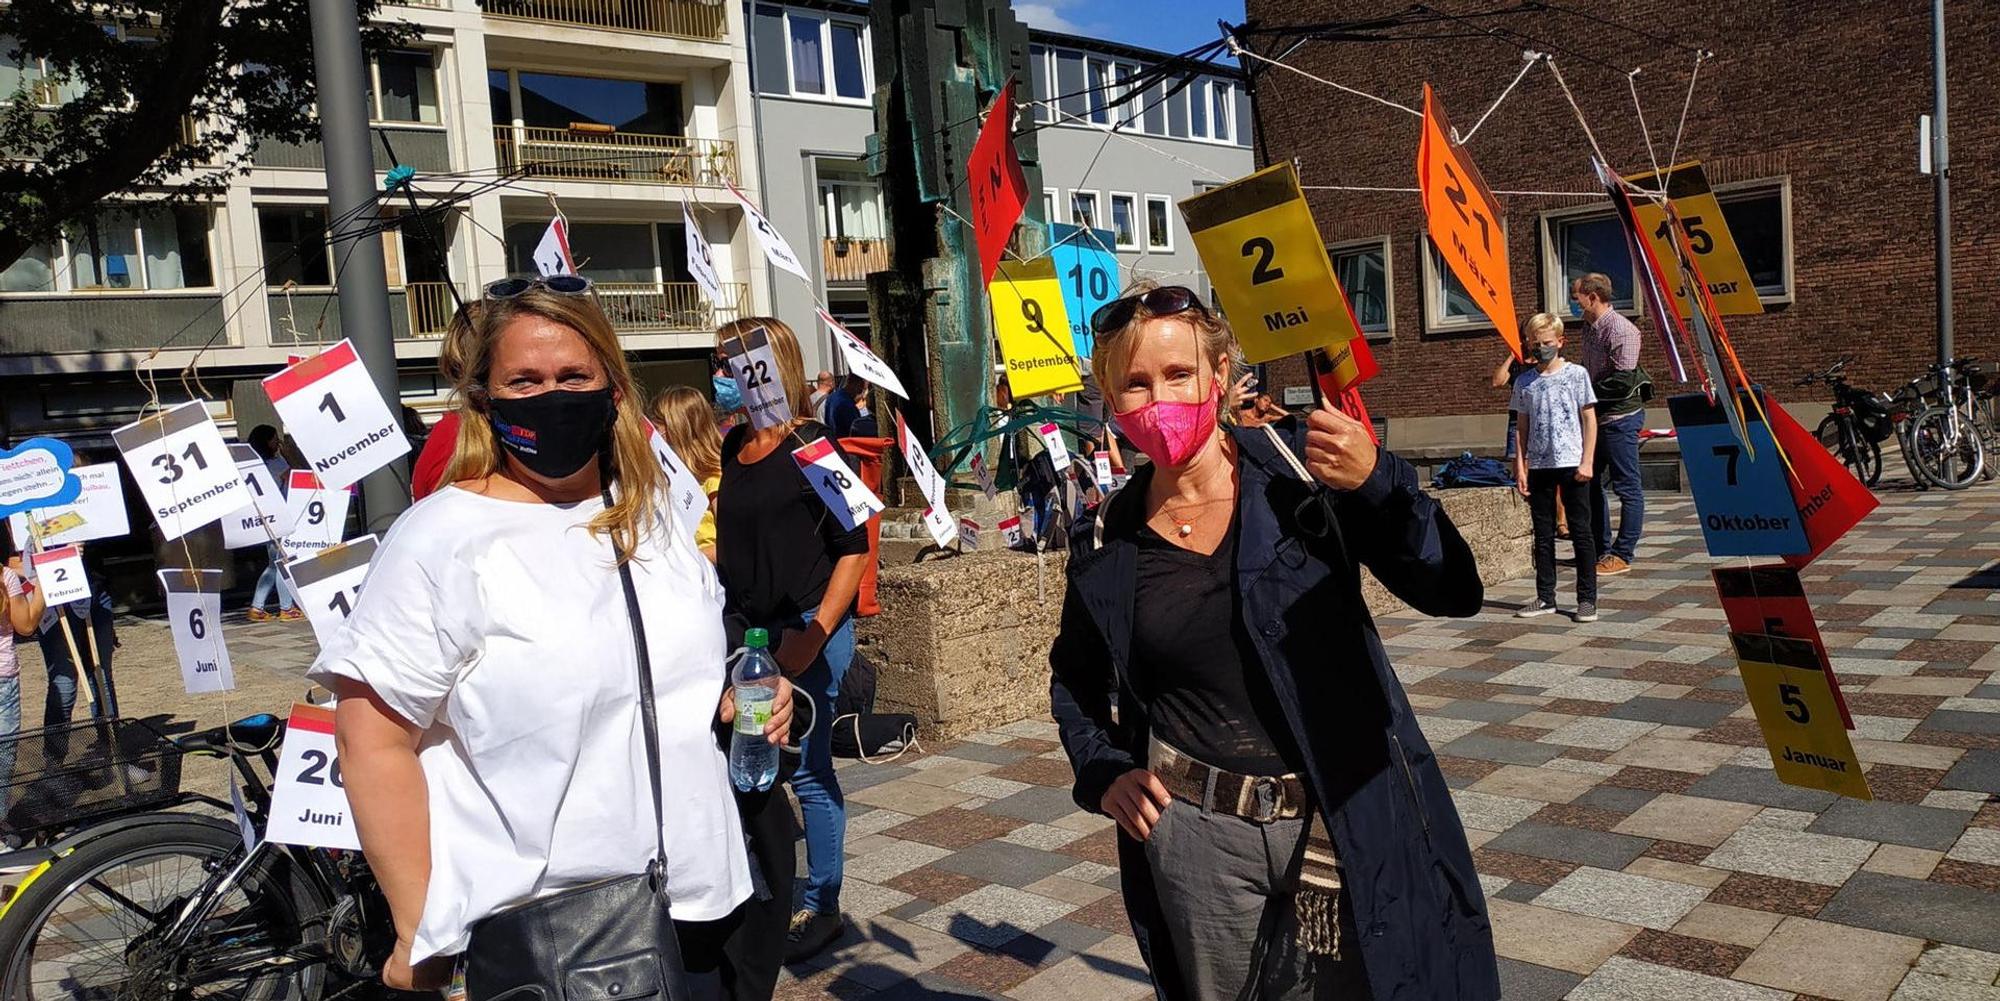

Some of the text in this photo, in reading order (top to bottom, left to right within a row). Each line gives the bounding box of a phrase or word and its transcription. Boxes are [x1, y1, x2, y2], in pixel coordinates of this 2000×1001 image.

[1444, 162, 1491, 258] 21
[1655, 216, 1714, 255] 15
[1242, 236, 1284, 286] 2
[1452, 229, 1498, 304] März
[1068, 263, 1109, 301] 10
[1676, 280, 1739, 298] Juar
[1021, 298, 1044, 333] 9
[1263, 306, 1309, 332] Mai
[742, 359, 772, 390] 22
[1009, 353, 1074, 372] September
[318, 391, 346, 423] 1
[315, 423, 395, 472] November
[151, 441, 208, 484] 31
[1712, 445, 1739, 486] 7
[0, 483, 22, 498] egen
[244, 472, 264, 496] 1
[822, 470, 852, 496] 18
[158, 478, 239, 519] September
[308, 501, 325, 525] 9
[847, 500, 870, 518] März
[241, 514, 276, 531] März
[1707, 513, 1790, 532] Oktober
[54, 567, 68, 583] 2
[48, 586, 84, 599] Februar
[328, 584, 361, 619] 1
[189, 608, 205, 639] 6
[195, 659, 218, 673] Juni
[1779, 684, 1810, 724] 5
[1782, 746, 1847, 773] Januar
[298, 808, 343, 826] Juni
